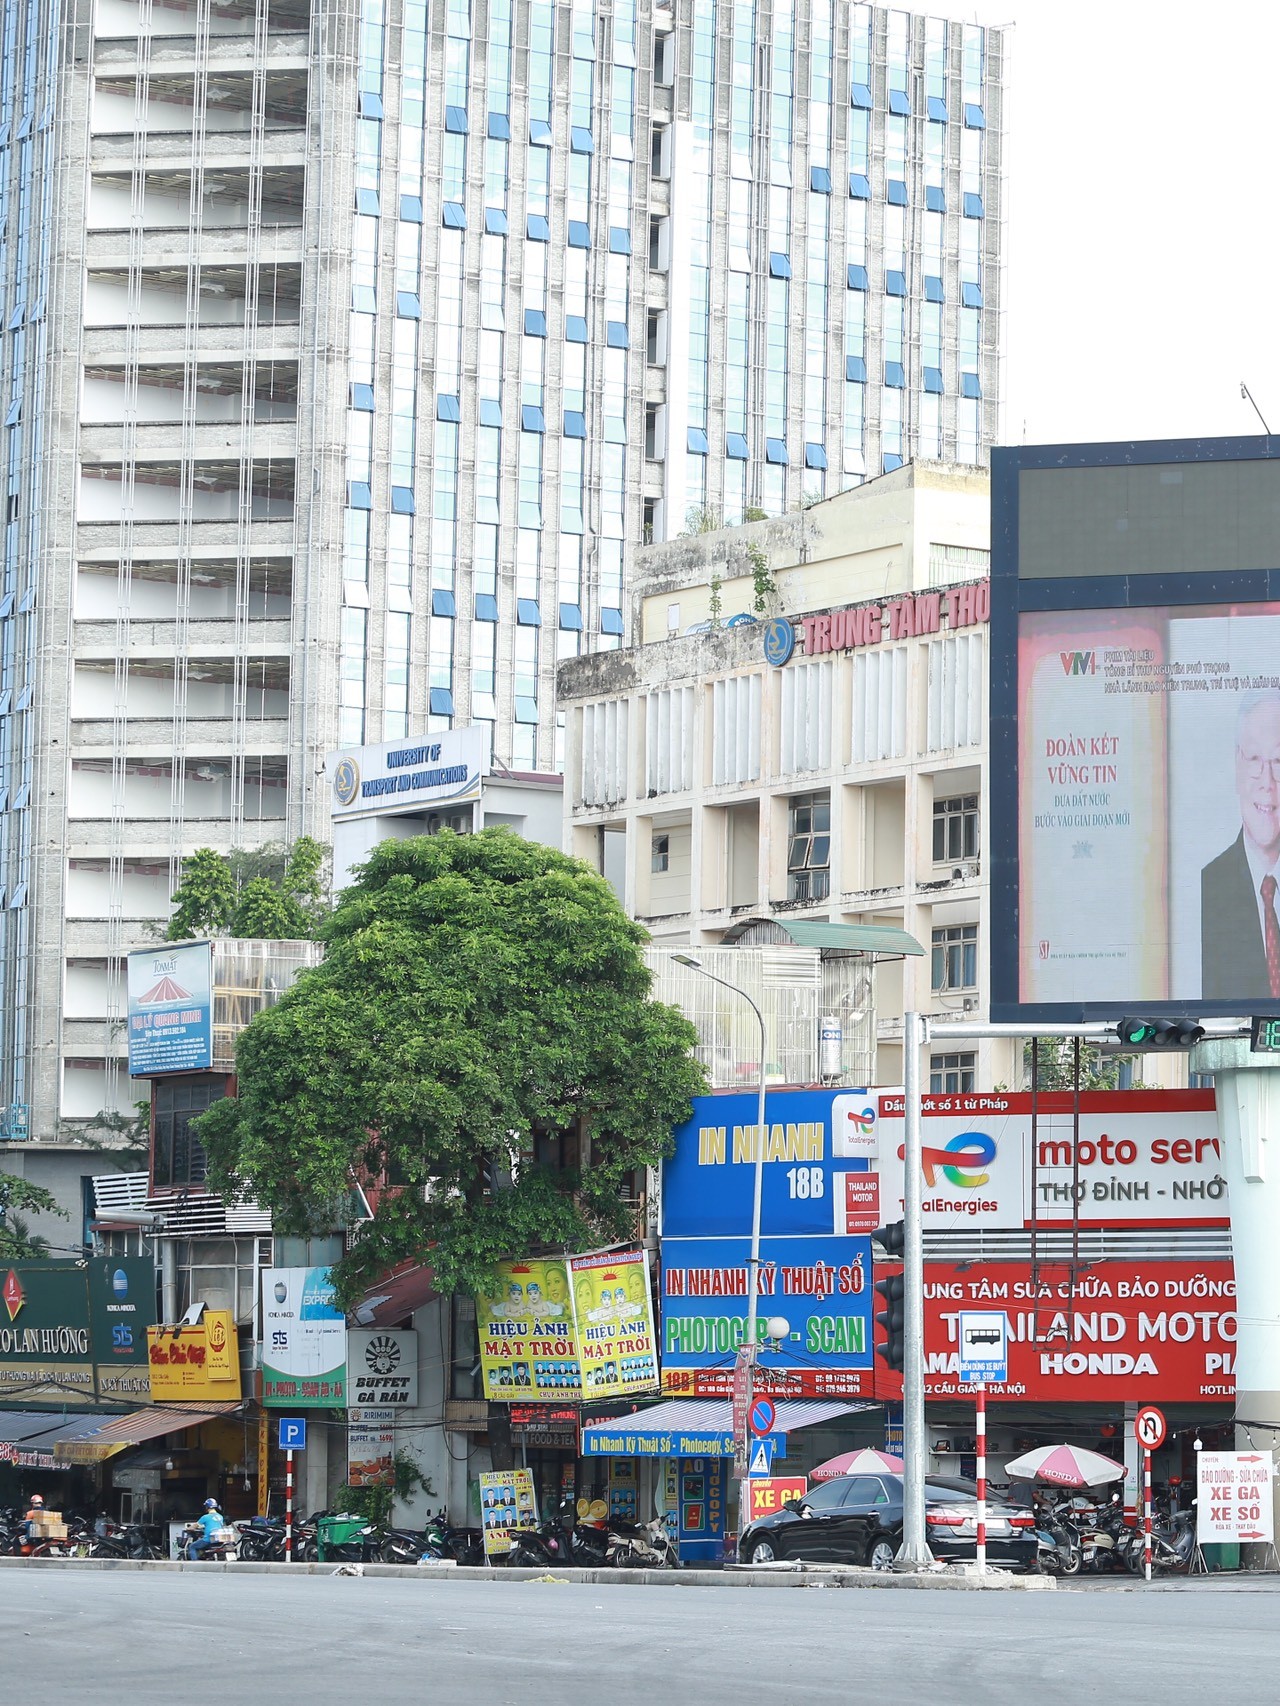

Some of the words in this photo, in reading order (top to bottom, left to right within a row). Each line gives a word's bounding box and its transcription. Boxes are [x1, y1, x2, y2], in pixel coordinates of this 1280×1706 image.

[802, 606, 881, 655] TRUNG
[1046, 732, 1086, 757] ĐOÀN
[387, 746, 429, 769] UNIVERSITY
[430, 744, 441, 761] OF
[361, 775, 397, 798] TRANSPORT
[398, 774, 411, 791] AND
[411, 764, 468, 790] COMMUNICATIONS
[1093, 765, 1117, 783] TIN
[938, 1096, 952, 1111] số
[954, 1099, 961, 1110] 1
[964, 1098, 977, 1110] từ
[979, 1097, 1009, 1113] Pháp
[698, 1126, 726, 1165] IN
[1039, 1133, 1136, 1166] moto
[786, 1167, 824, 1199] 18B
[848, 1182, 877, 1192] THAILAND
[1039, 1179, 1087, 1206] THỢ
[1092, 1176, 1149, 1201] ĐỈNH
[853, 1193, 873, 1202] MOTOR
[666, 1267, 686, 1296] IN
[688, 1267, 750, 1297] NHANH
[781, 1260, 836, 1301] THUẬT
[838, 1252, 865, 1295] SỐ
[968, 1278, 1008, 1299] TÂM
[1117, 1274, 1159, 1299] BẢO
[1164, 1273, 1237, 1299] DƯỠNG
[488, 1319, 528, 1338] HIỆU
[533, 1318, 568, 1336] ẢNH
[586, 1324, 616, 1342] HIỆU
[619, 1319, 646, 1338] ẢNH
[806, 1316, 866, 1354] SCAN
[13, 1328, 40, 1353] LAN
[485, 1337, 524, 1358] MẶT
[529, 1338, 575, 1356] TRỜI
[583, 1342, 614, 1361] MẶT
[616, 1337, 651, 1355] TRỜI
[1040, 1353, 1159, 1375] HONDA
[356, 1377, 410, 1388] BUFFET
[666, 1372, 689, 1392] 18B
[970, 1372, 981, 1380] BUS
[982, 1371, 996, 1380] STOP
[380, 1389, 409, 1403] RÁN
[934, 1381, 956, 1394] CẦU
[989, 1382, 1005, 1394] HÀ
[1007, 1381, 1026, 1397] NỘI
[364, 1411, 393, 1420] RIRIMIMI
[287, 1425, 299, 1443] P
[530, 1433, 553, 1445] FOOD
[561, 1433, 576, 1446] TEA
[590, 1436, 599, 1452] In
[600, 1436, 624, 1452] Nhanh
[626, 1435, 636, 1454] Kỹ
[638, 1436, 659, 1456] Thuật
[660, 1434, 672, 1453] Số
[680, 1437, 722, 1455] Photocopy,
[1043, 1468, 1078, 1483] HONDA
[1201, 1467, 1214, 1483] BẢO
[753, 1489, 776, 1508] XE
[1211, 1486, 1232, 1501] XE
[1238, 1486, 1260, 1500] GA
[1210, 1507, 1232, 1521] XE
[1237, 1501, 1261, 1521] SỐ
